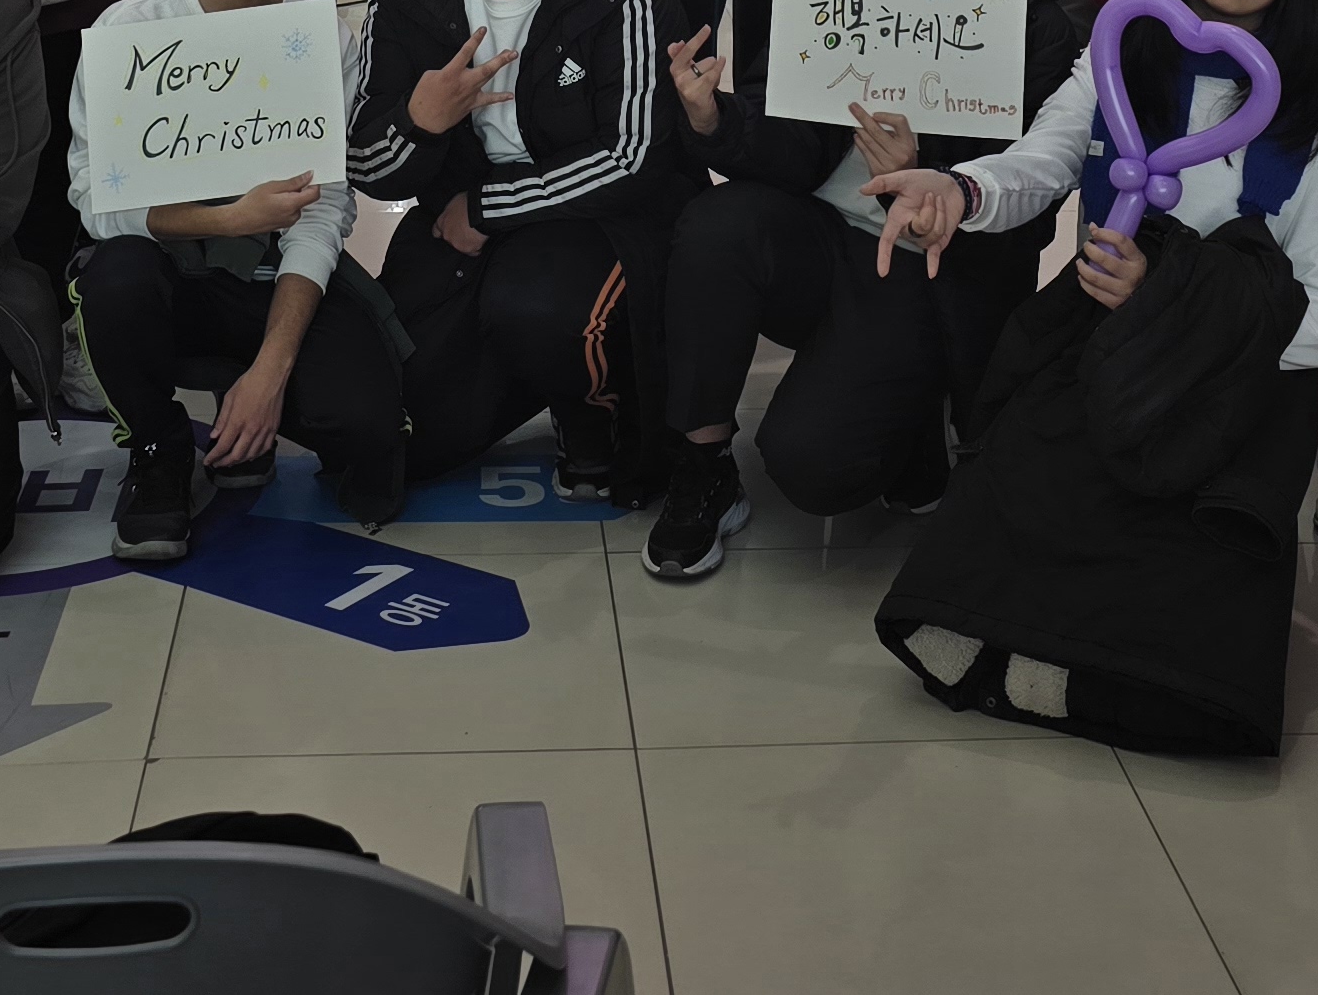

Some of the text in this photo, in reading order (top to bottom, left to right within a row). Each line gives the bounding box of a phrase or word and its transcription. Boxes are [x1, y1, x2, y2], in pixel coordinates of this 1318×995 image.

[124, 39, 241, 97] Merry
[826, 62, 1018, 116] Merry Christmas
[142, 109, 326, 159] Christmas
[324, 564, 451, 626] 1동
